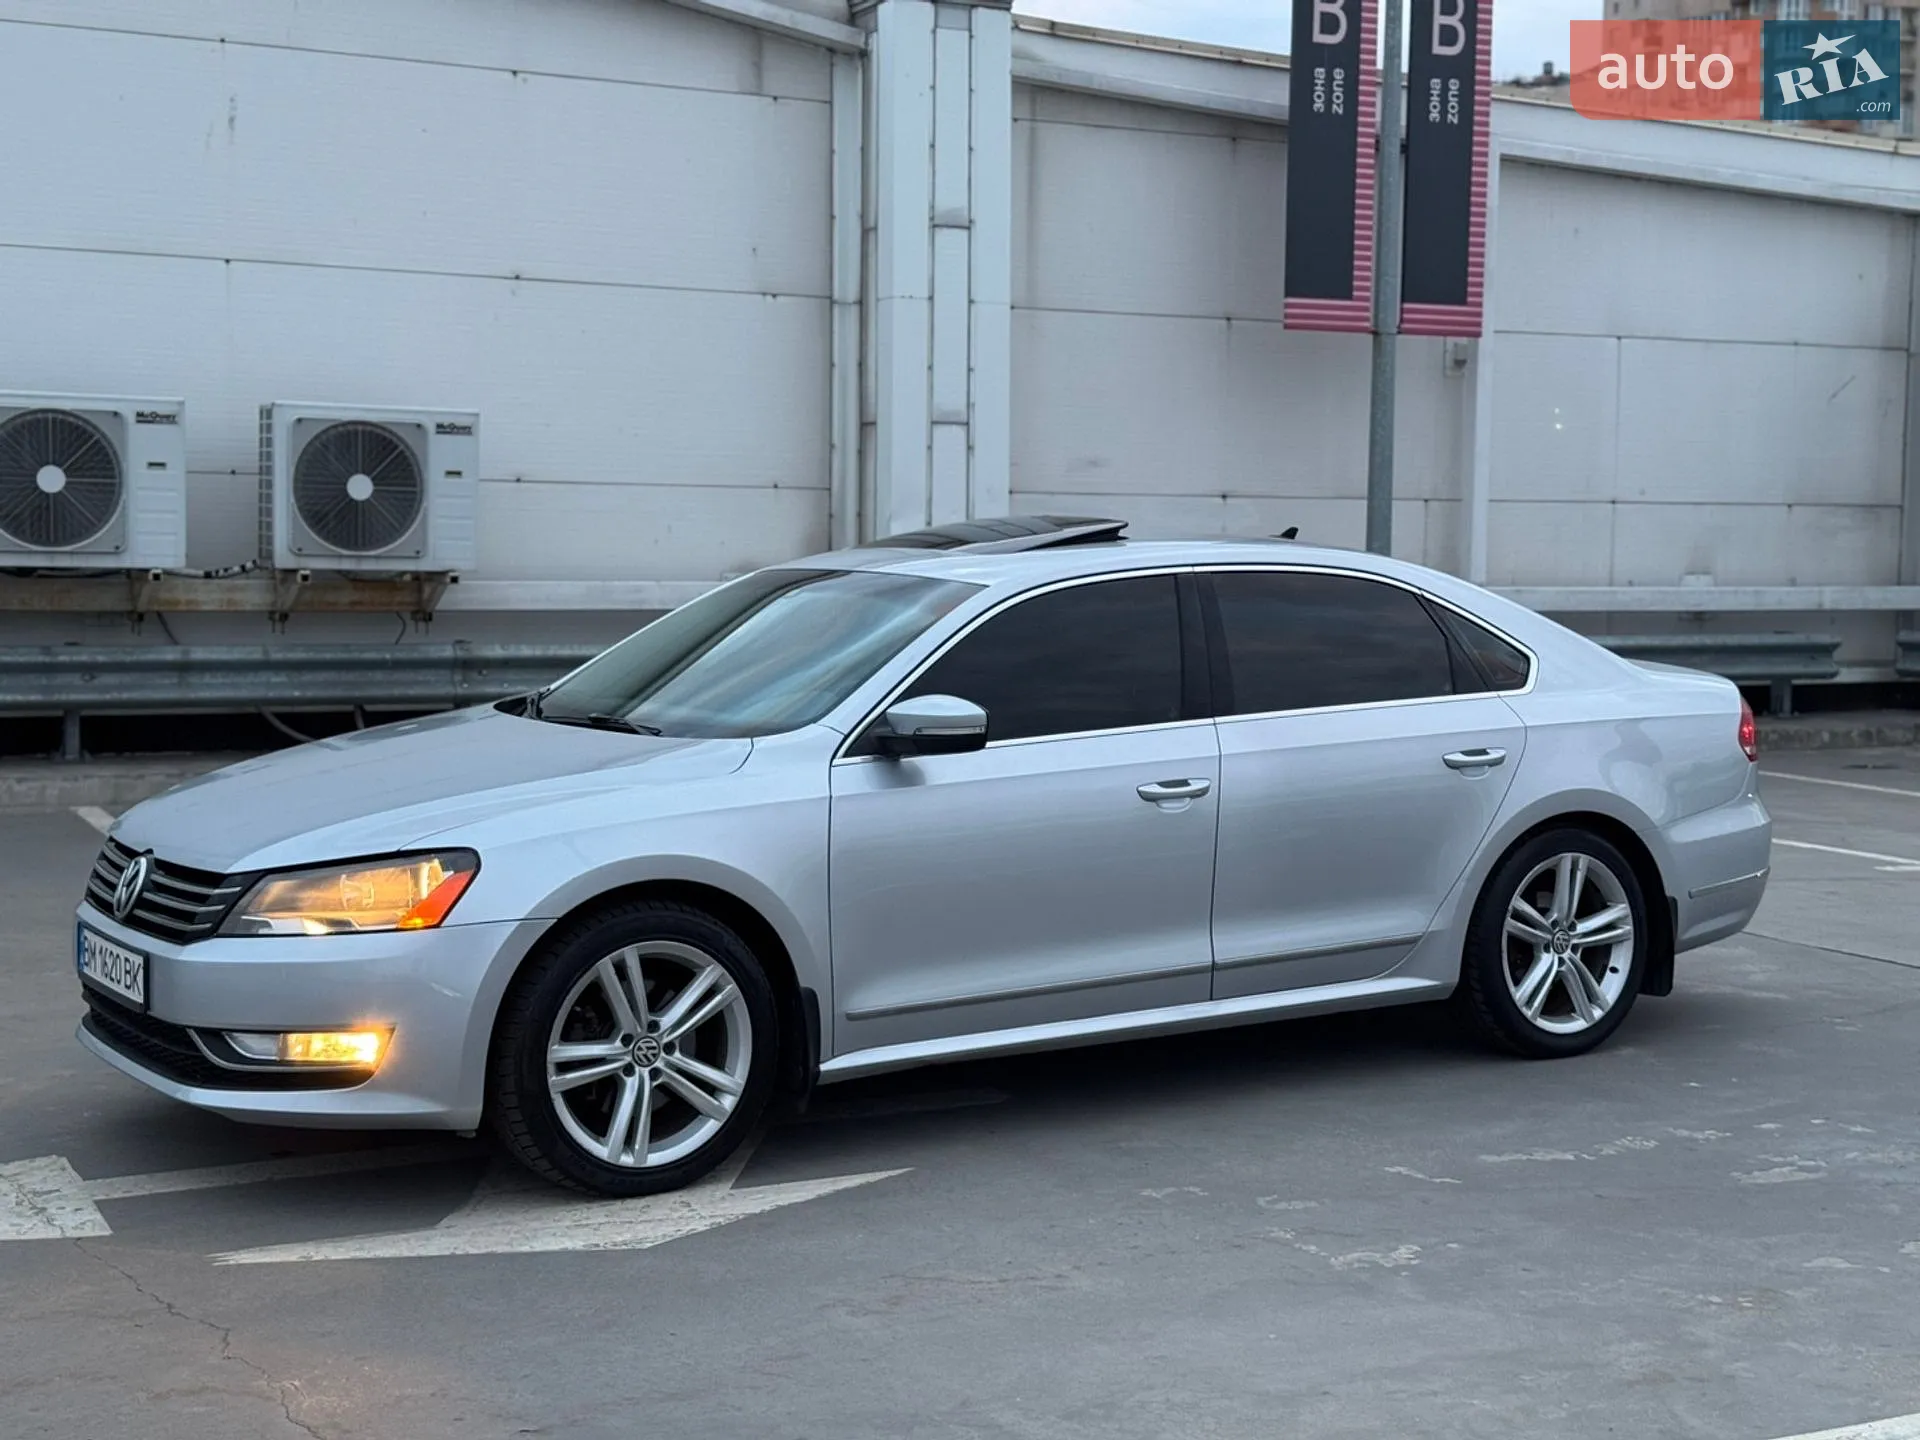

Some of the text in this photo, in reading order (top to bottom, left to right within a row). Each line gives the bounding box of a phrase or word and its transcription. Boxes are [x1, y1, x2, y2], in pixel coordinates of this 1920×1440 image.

[1313, 67, 1326, 113] зона
[1332, 67, 1345, 115] zone
[1429, 78, 1442, 123] зона
[1447, 78, 1460, 125] zone
[124, 956, 142, 997] BK
